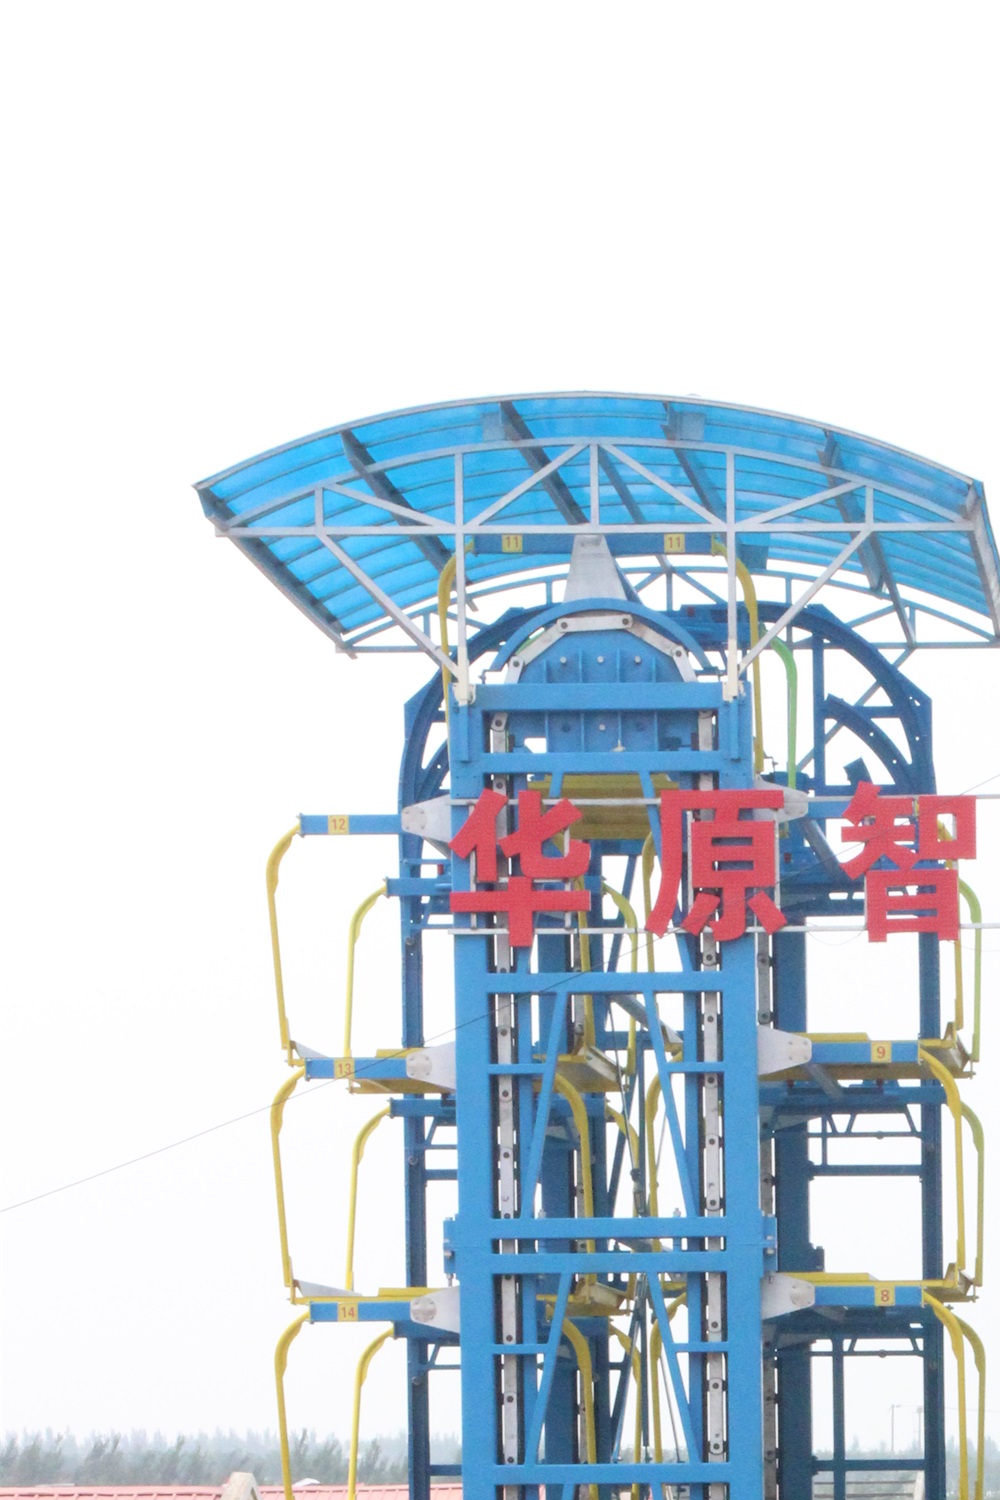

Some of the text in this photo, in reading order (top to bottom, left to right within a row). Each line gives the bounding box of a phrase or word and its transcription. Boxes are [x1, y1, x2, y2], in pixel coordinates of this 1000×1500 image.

[504, 535, 520, 549] 11
[668, 535, 682, 549] 11
[331, 817, 346, 832] 12
[877, 1044, 886, 1059] 9
[338, 1062, 352, 1077] 13
[880, 1289, 890, 1304] 8
[342, 1305, 355, 1319] 14
